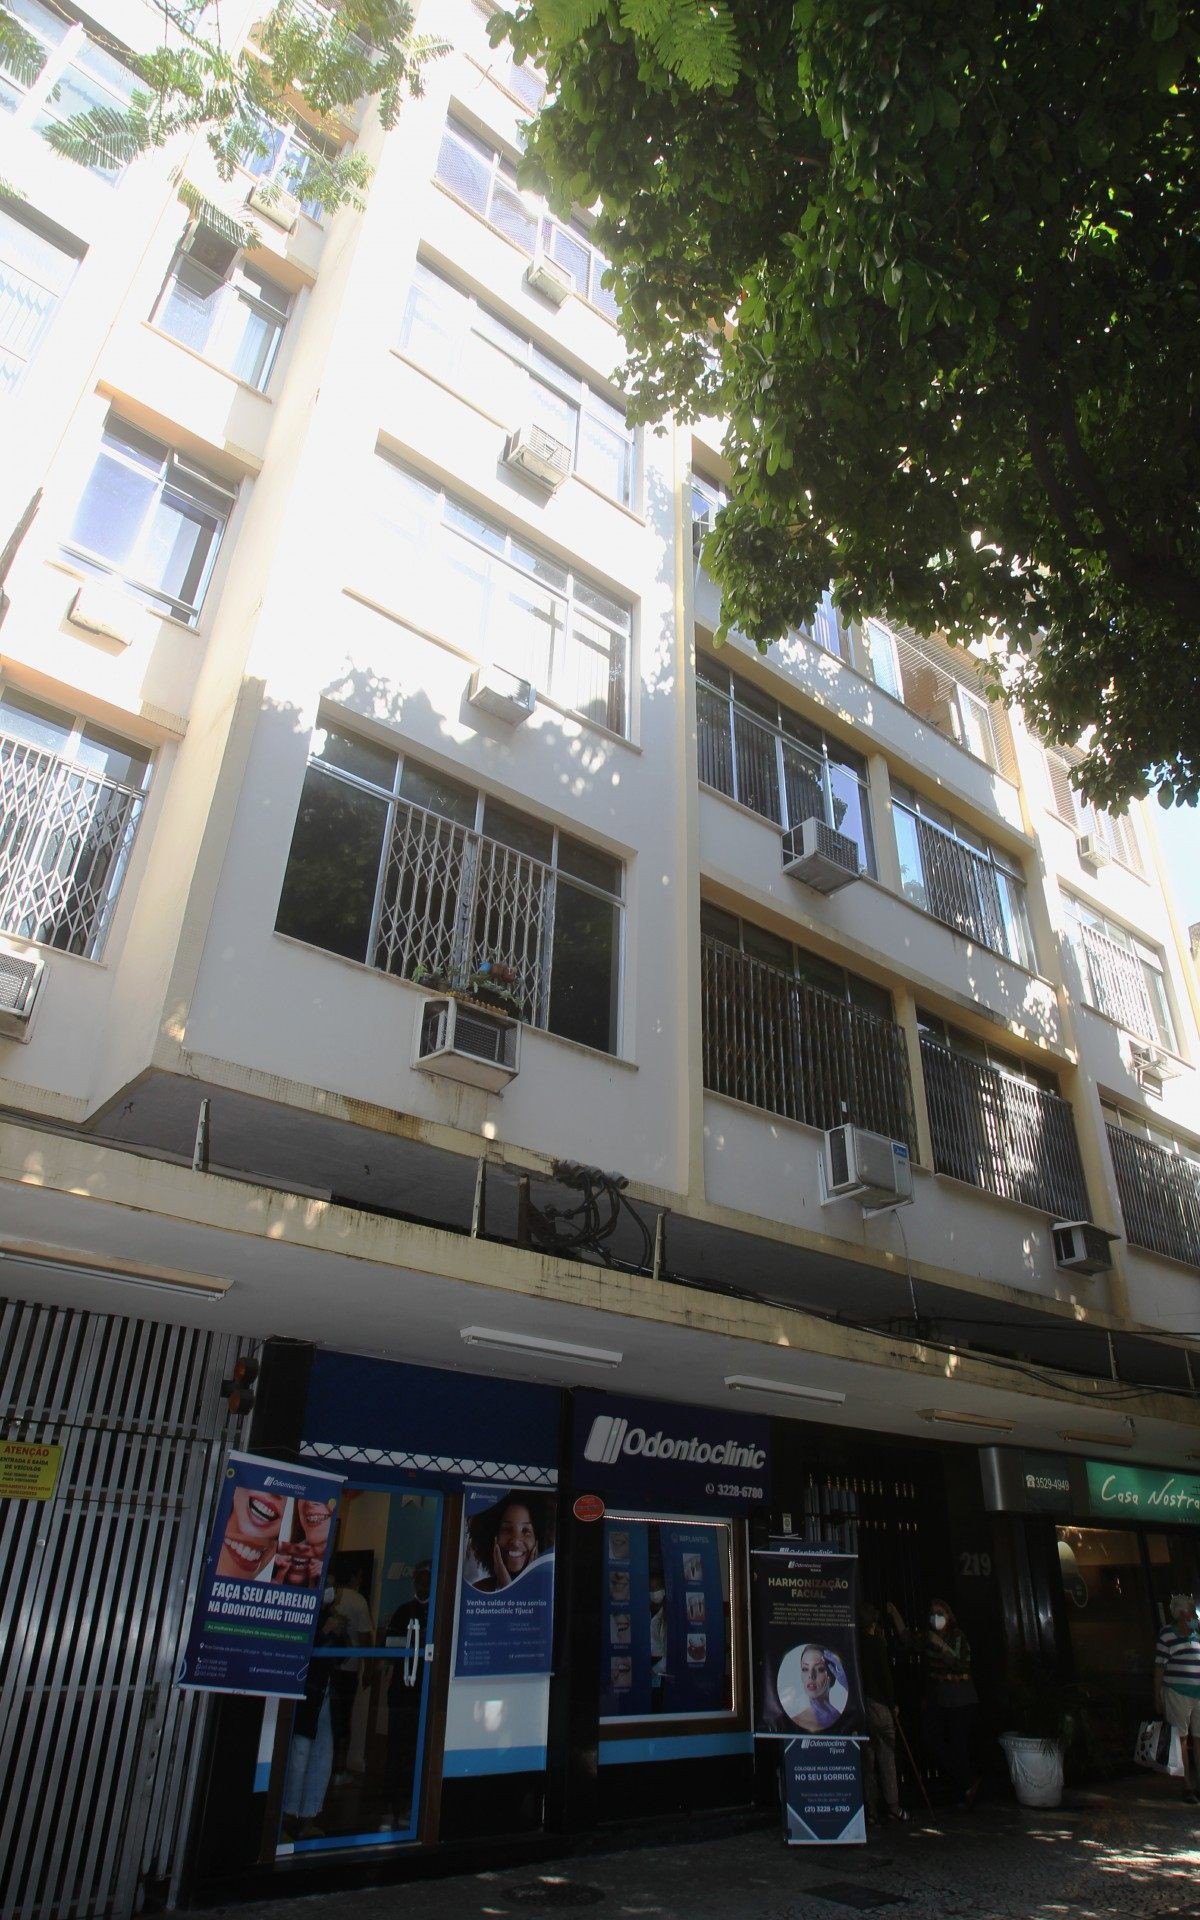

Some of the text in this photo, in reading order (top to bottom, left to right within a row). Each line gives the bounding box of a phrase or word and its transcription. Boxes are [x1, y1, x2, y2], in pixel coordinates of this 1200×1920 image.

[4, 1446, 50, 1457] ATENÇÃO
[622, 1428, 767, 1469] Odontoclinic
[717, 1484, 763, 1499] 3228-6780
[1101, 1474, 1200, 1510] Casa Nostra
[960, 1552, 992, 1576] 219
[211, 1582, 316, 1610] FAÇA SEU APARELHO
[768, 1578, 848, 1591] HARMONIZAÇÃO
[792, 1589, 826, 1598] FACIAL
[208, 1601, 314, 1625] NA ODONTOCLINIC TIJUCA!
